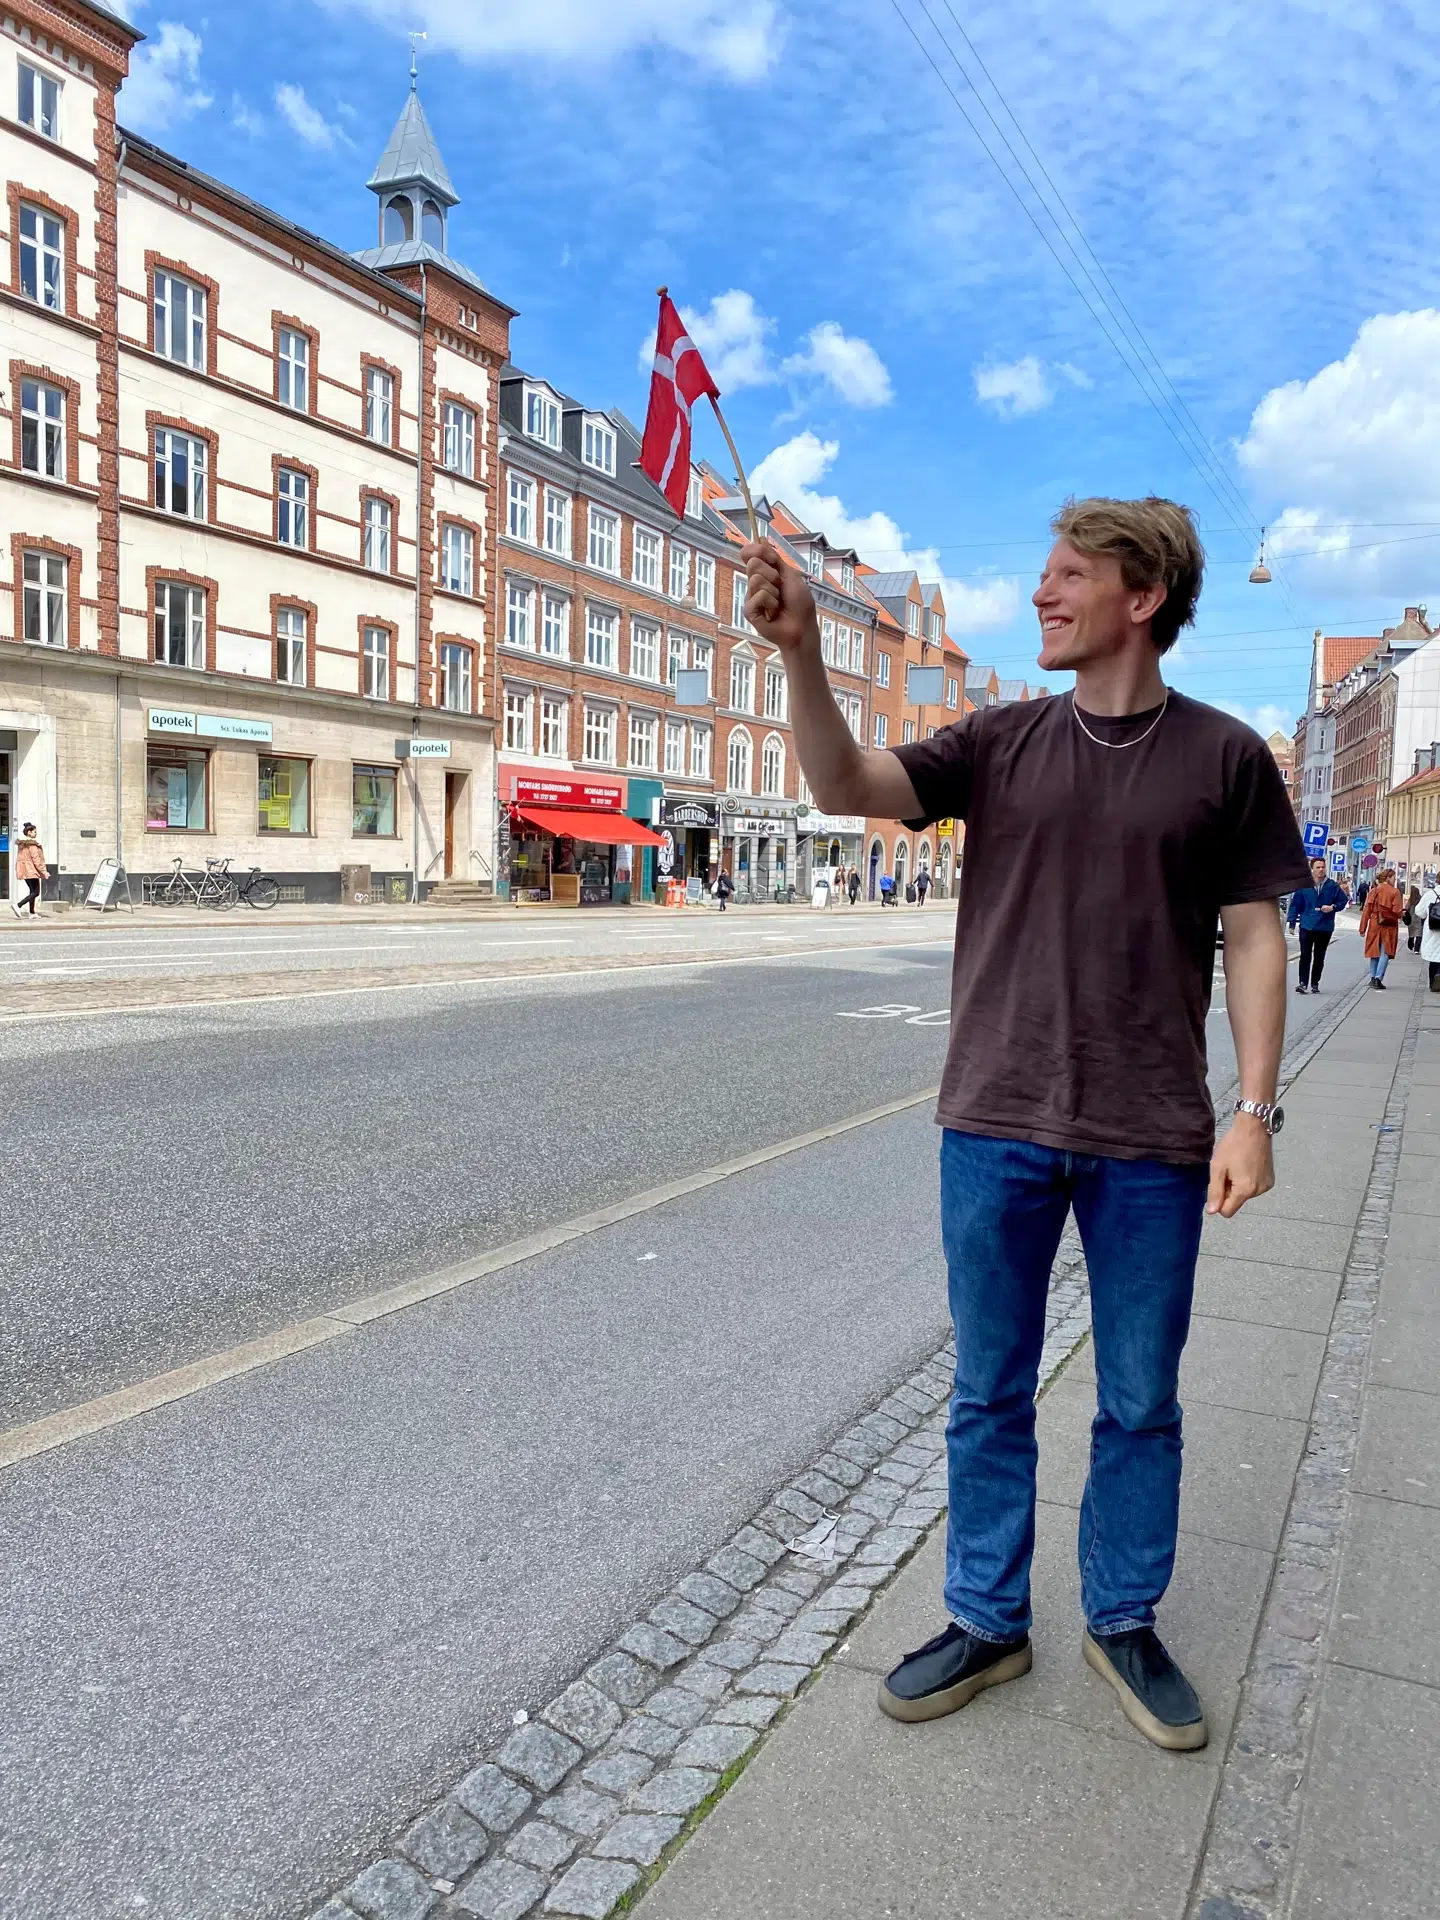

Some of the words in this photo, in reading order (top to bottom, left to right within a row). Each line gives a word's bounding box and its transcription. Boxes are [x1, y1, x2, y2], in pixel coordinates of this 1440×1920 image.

[152, 715, 193, 728] apotek
[233, 726, 249, 734] Lukas
[250, 728, 269, 736] Apotek
[412, 743, 448, 755] apotek
[674, 808, 708, 825] BARBERSHOP
[1309, 826, 1324, 842] P
[1336, 854, 1343, 863] P
